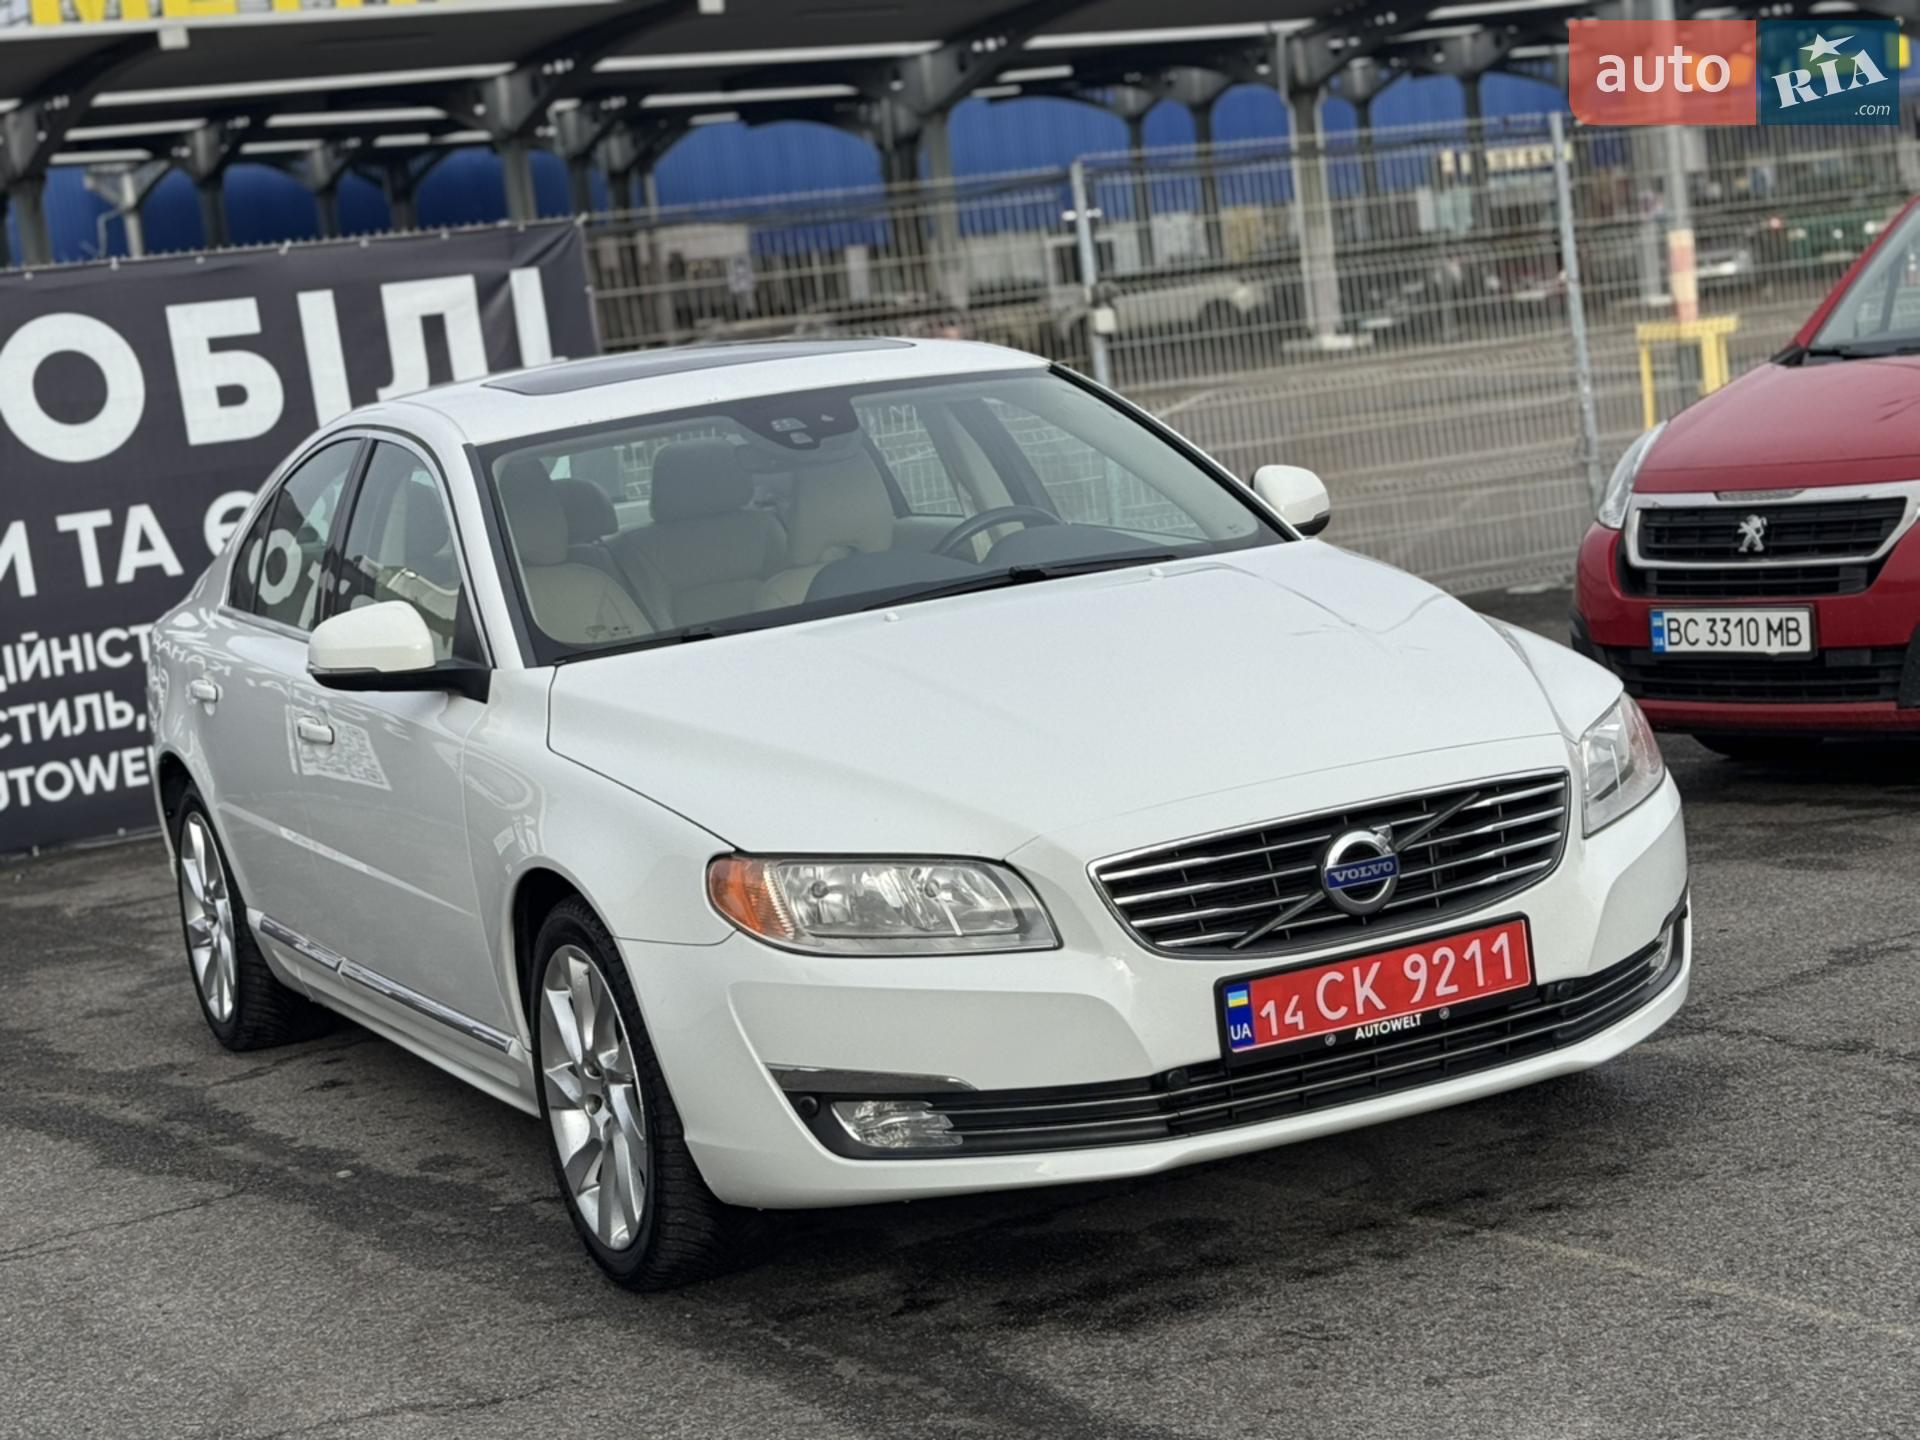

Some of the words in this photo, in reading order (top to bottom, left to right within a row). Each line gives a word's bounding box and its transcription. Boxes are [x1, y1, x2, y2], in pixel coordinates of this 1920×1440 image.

[55, 503, 185, 588] ТА
[1666, 617, 1701, 647] BC
[1705, 617, 1760, 647] 3310
[1766, 617, 1802, 647] MB
[0, 623, 154, 693] ІЙНІСТ
[1331, 861, 1394, 882] VOLVO
[1230, 1022, 1252, 1040] UA
[1259, 994, 1305, 1036] 14
[1315, 961, 1387, 1020] CK
[1402, 931, 1512, 1004] 9211
[1354, 1013, 1422, 1040] AUTOWELT
